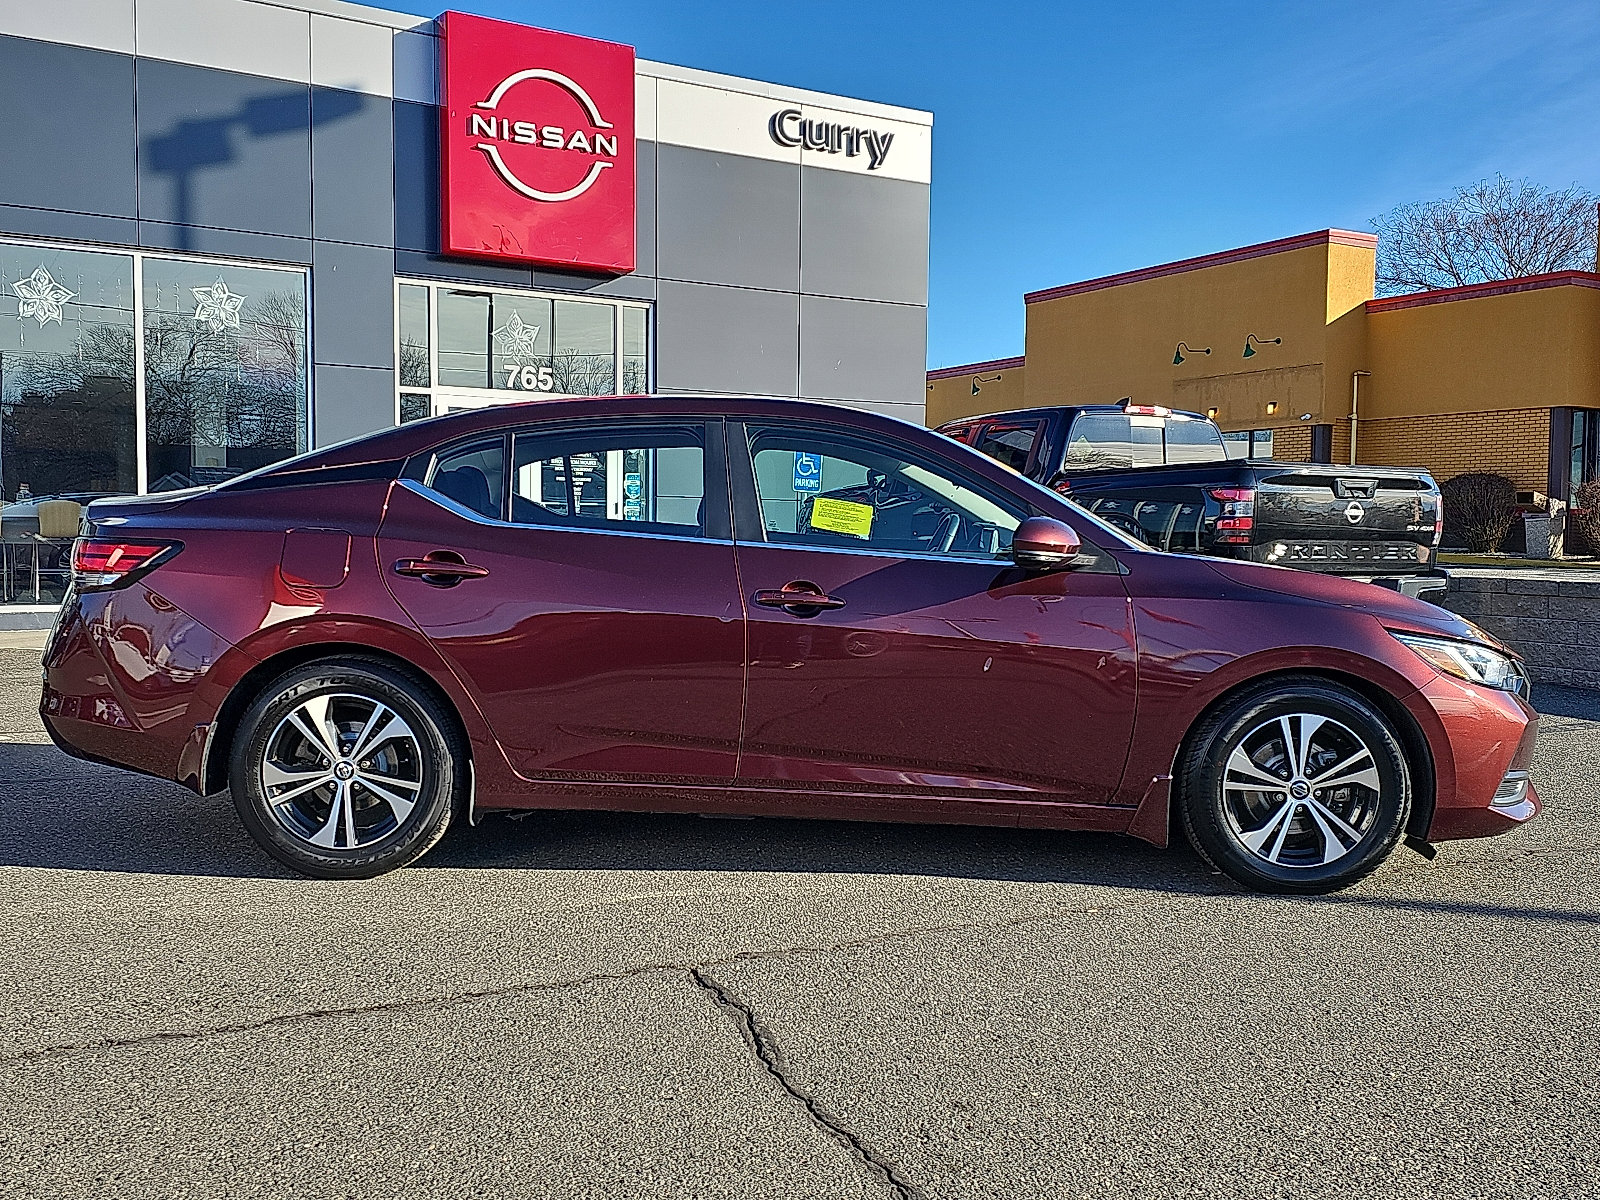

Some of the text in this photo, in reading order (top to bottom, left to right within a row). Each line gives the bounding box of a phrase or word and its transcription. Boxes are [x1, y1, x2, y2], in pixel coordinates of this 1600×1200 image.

[471, 113, 618, 158] NISSAN
[768, 109, 895, 170] Curry
[503, 364, 553, 391] 765
[795, 478, 819, 487] PARKING
